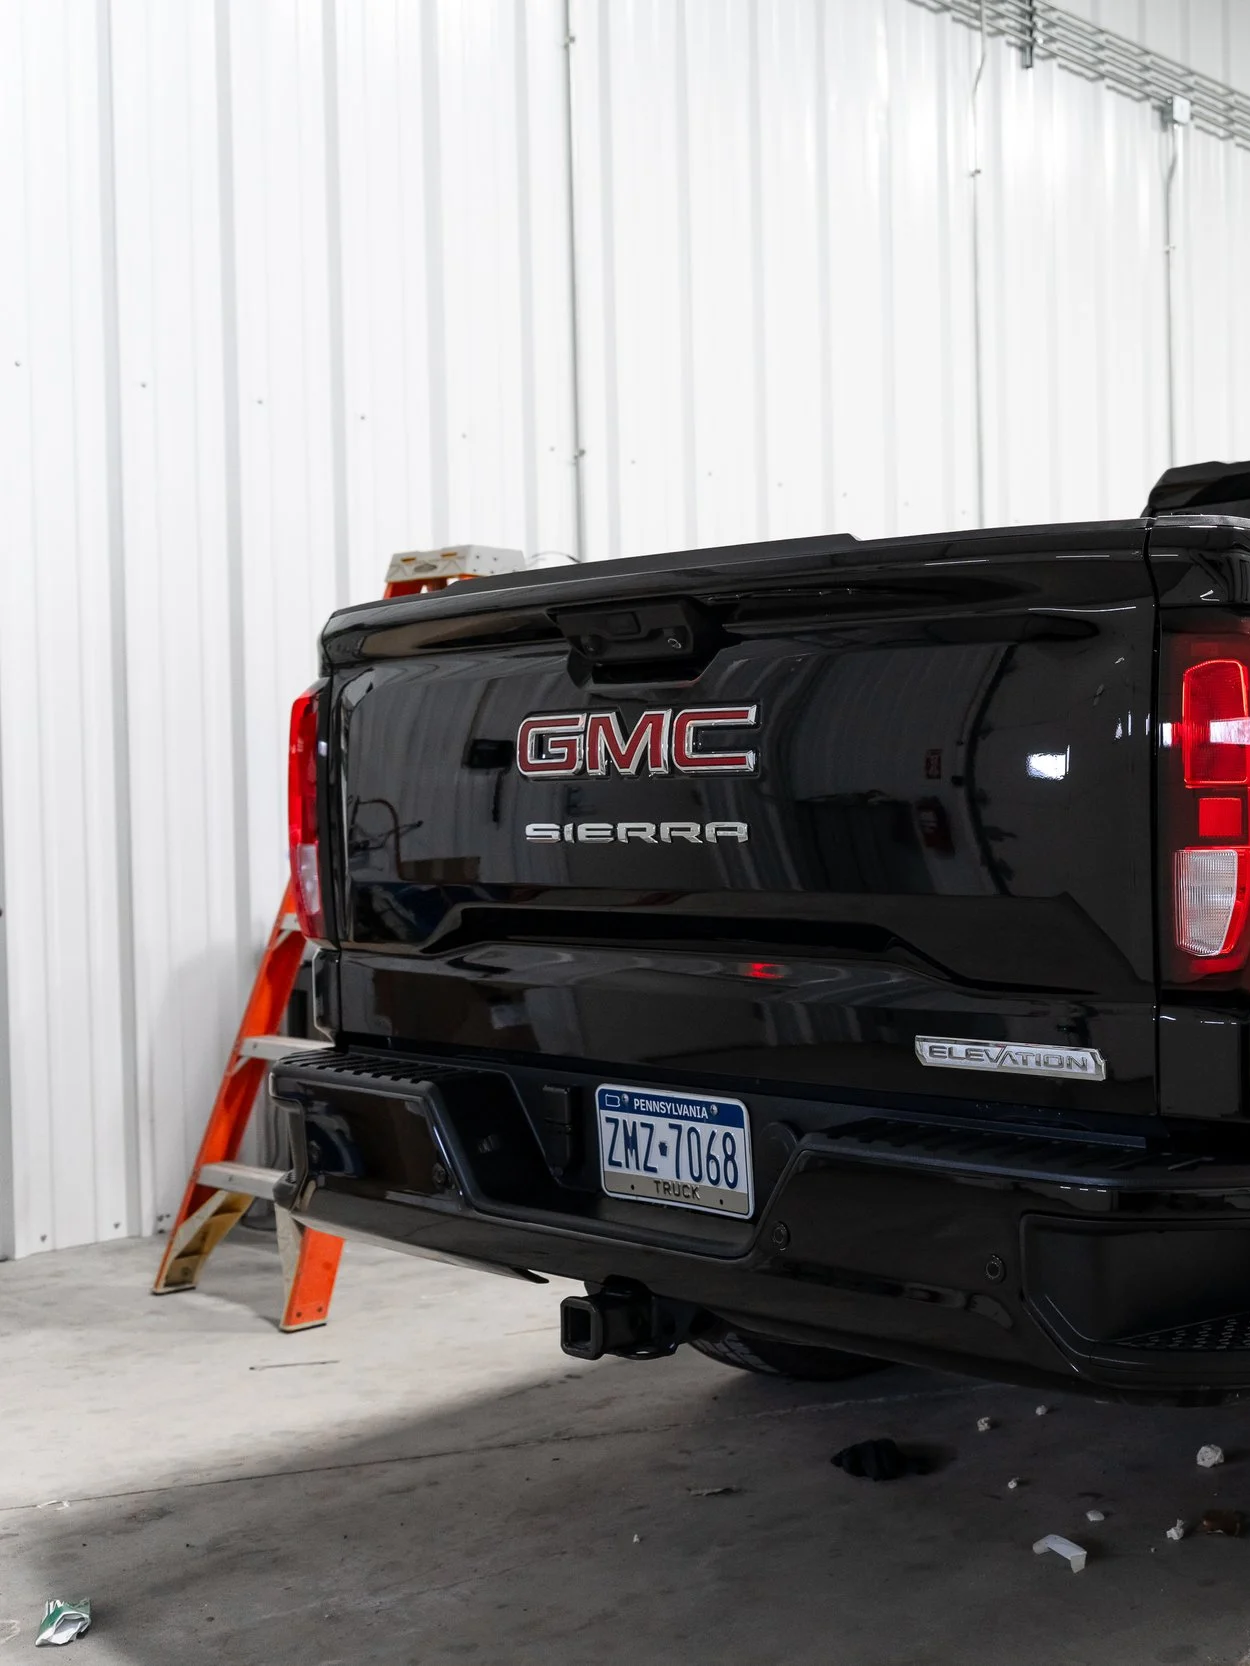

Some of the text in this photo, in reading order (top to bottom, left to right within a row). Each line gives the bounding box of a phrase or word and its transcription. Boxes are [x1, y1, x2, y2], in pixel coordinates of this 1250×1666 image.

[517, 704, 757, 777] GMC
[525, 821, 748, 844] SIERRA
[928, 1045, 1088, 1071] ELEVATION
[633, 1098, 709, 1119] PENNSYLVANIA
[605, 1116, 739, 1189] ZMZ 7068
[653, 1180, 700, 1200] TRUCK
